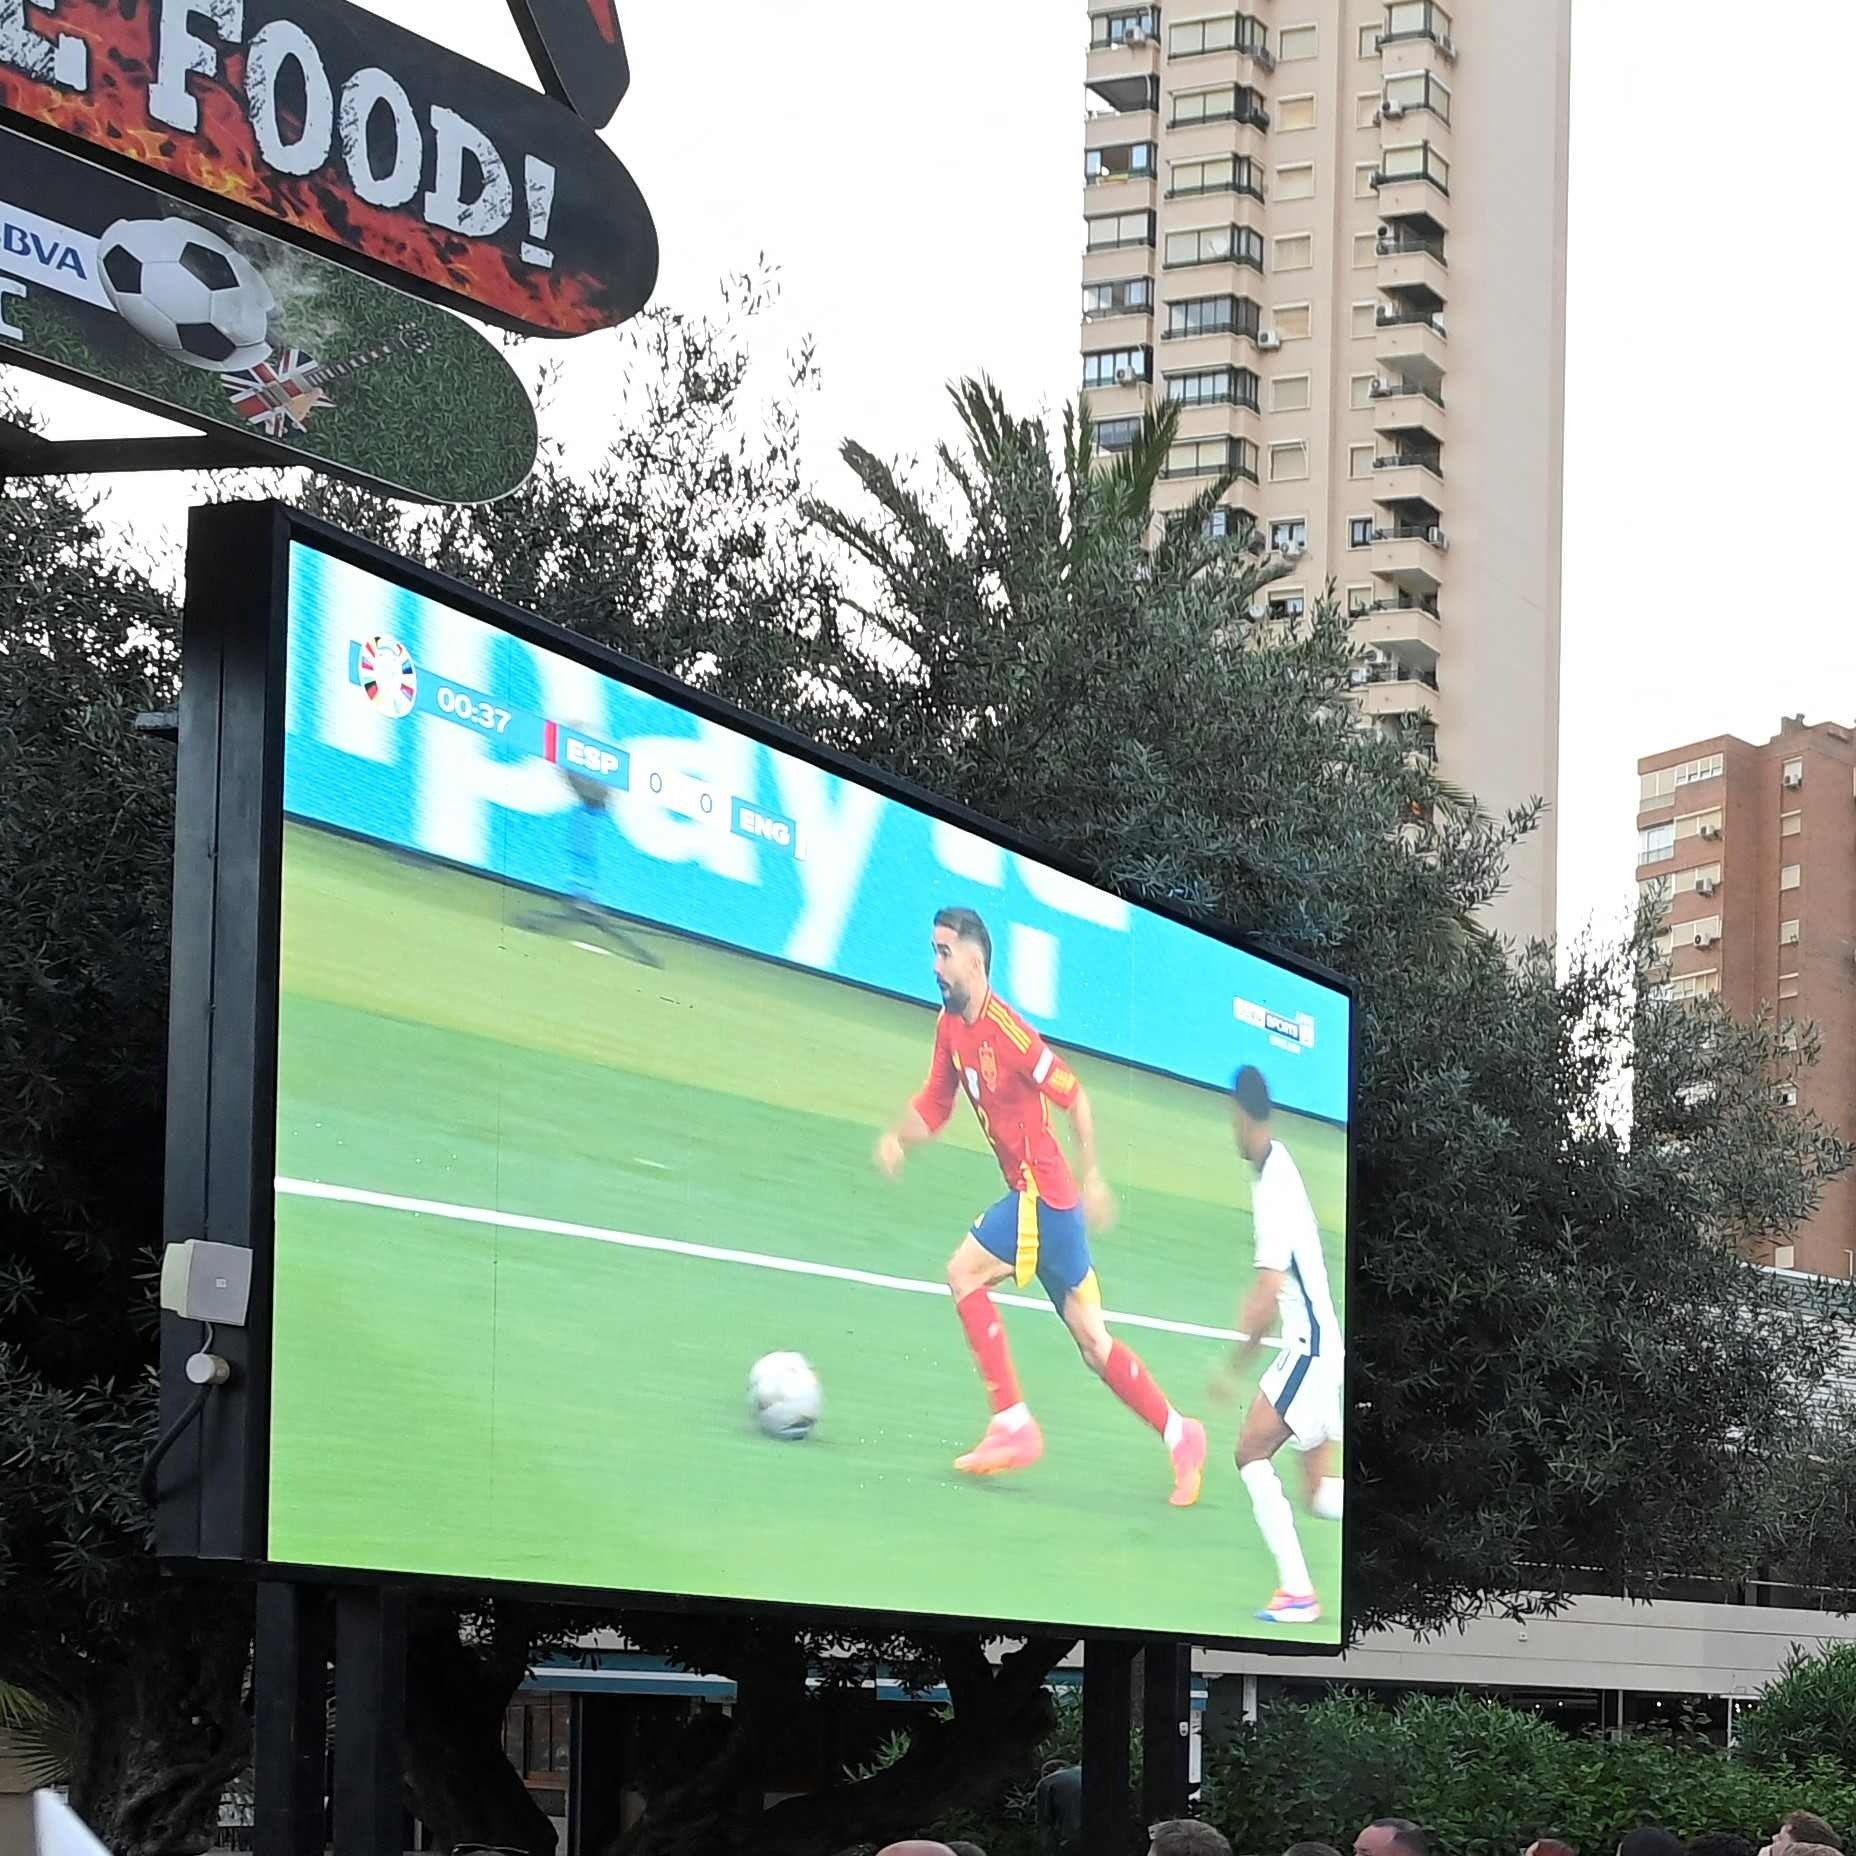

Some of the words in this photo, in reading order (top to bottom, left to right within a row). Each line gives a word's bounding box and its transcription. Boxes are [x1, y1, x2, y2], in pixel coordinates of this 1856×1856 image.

[149, 0, 556, 268] FOOD!
[0, 222, 88, 281] BVA
[435, 685, 513, 734] 00:37
[565, 738, 620, 776] ESP
[737, 807, 792, 847] ENG
